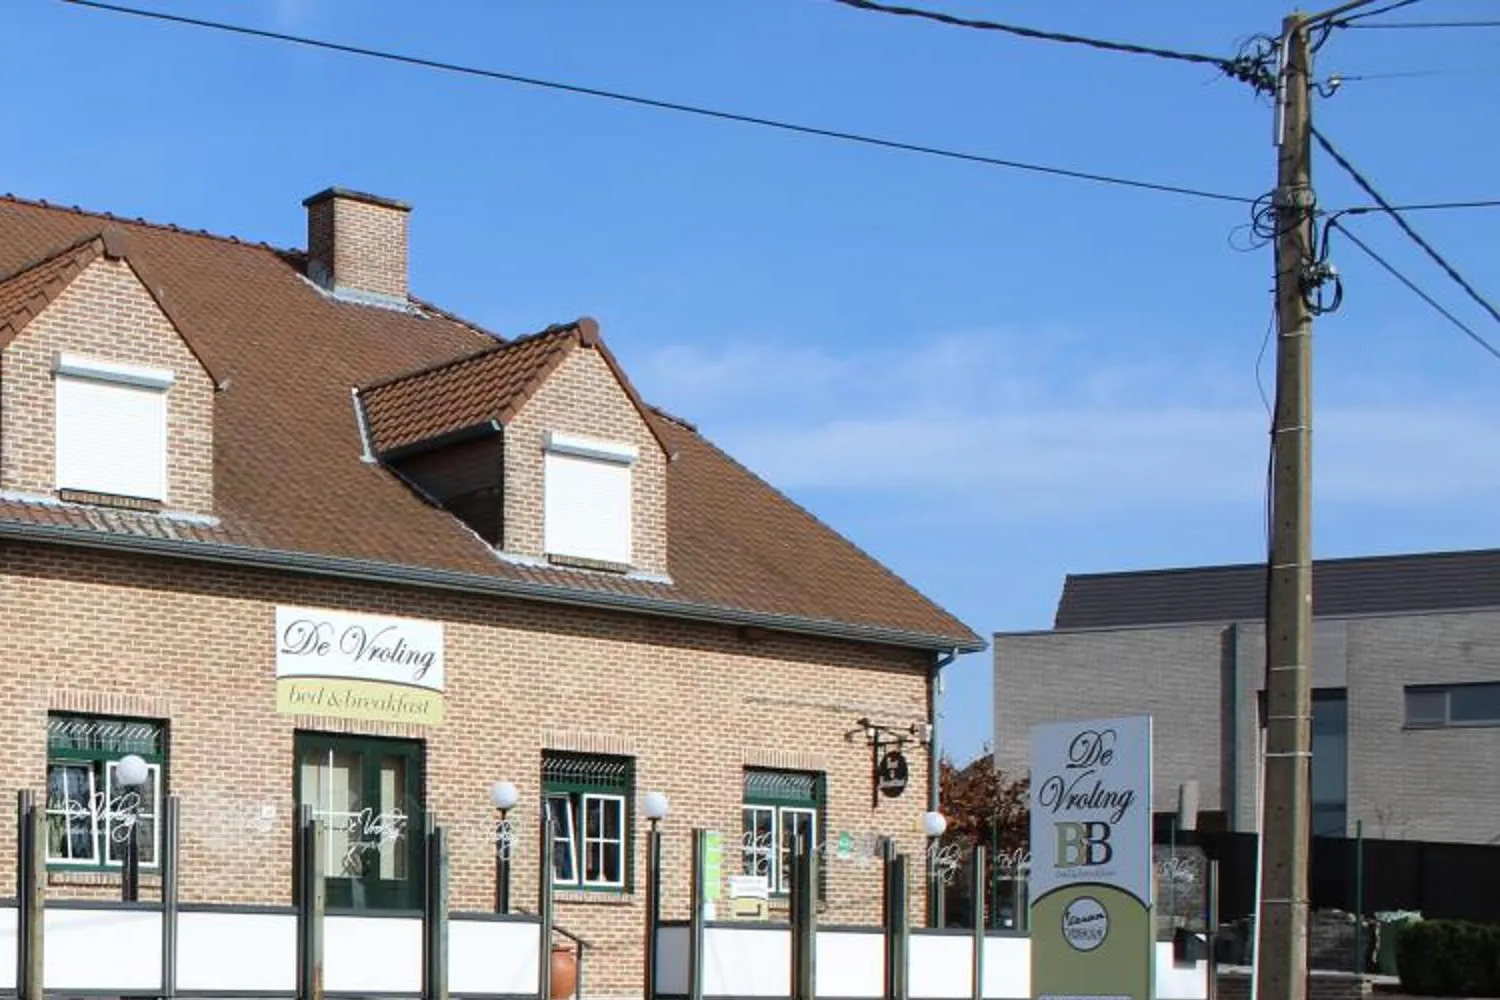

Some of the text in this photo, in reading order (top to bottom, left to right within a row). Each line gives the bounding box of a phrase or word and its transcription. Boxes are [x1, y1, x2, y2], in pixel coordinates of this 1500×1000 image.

[281, 618, 437, 681] De Vroling
[288, 685, 324, 706] bed
[344, 688, 430, 717] breakfast
[1065, 729, 1117, 769] De
[1039, 769, 1136, 825] Vroling
